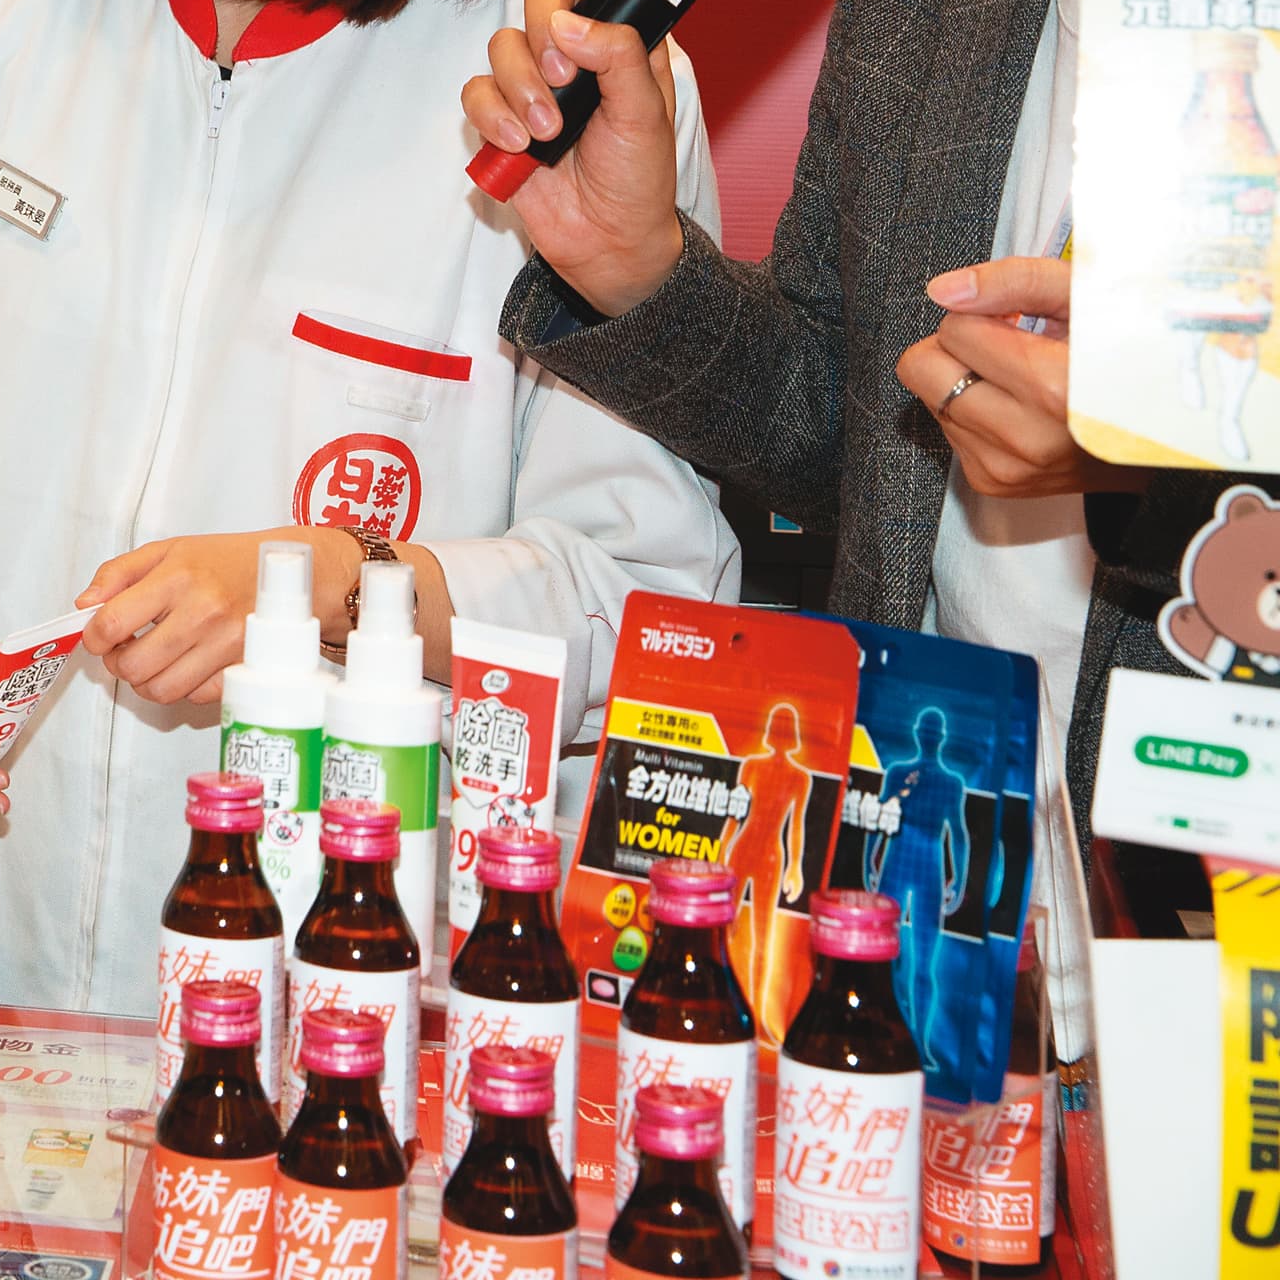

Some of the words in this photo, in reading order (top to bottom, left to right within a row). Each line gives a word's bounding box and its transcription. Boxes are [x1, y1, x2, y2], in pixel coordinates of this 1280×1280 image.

[326, 456, 408, 511] 日藥
[640, 626, 716, 661] マルチビタミン
[456, 699, 528, 755] 除菌
[226, 732, 295, 776] 抗菌
[323, 746, 380, 791] 抗菌
[455, 746, 518, 782] 乾洗手
[634, 749, 662, 765] Multi
[664, 755, 704, 773] Vitamin
[1146, 740, 1195, 767] LINE
[625, 766, 751, 821] 全方位維他命
[655, 806, 682, 827] for
[618, 819, 722, 864] WOMEN
